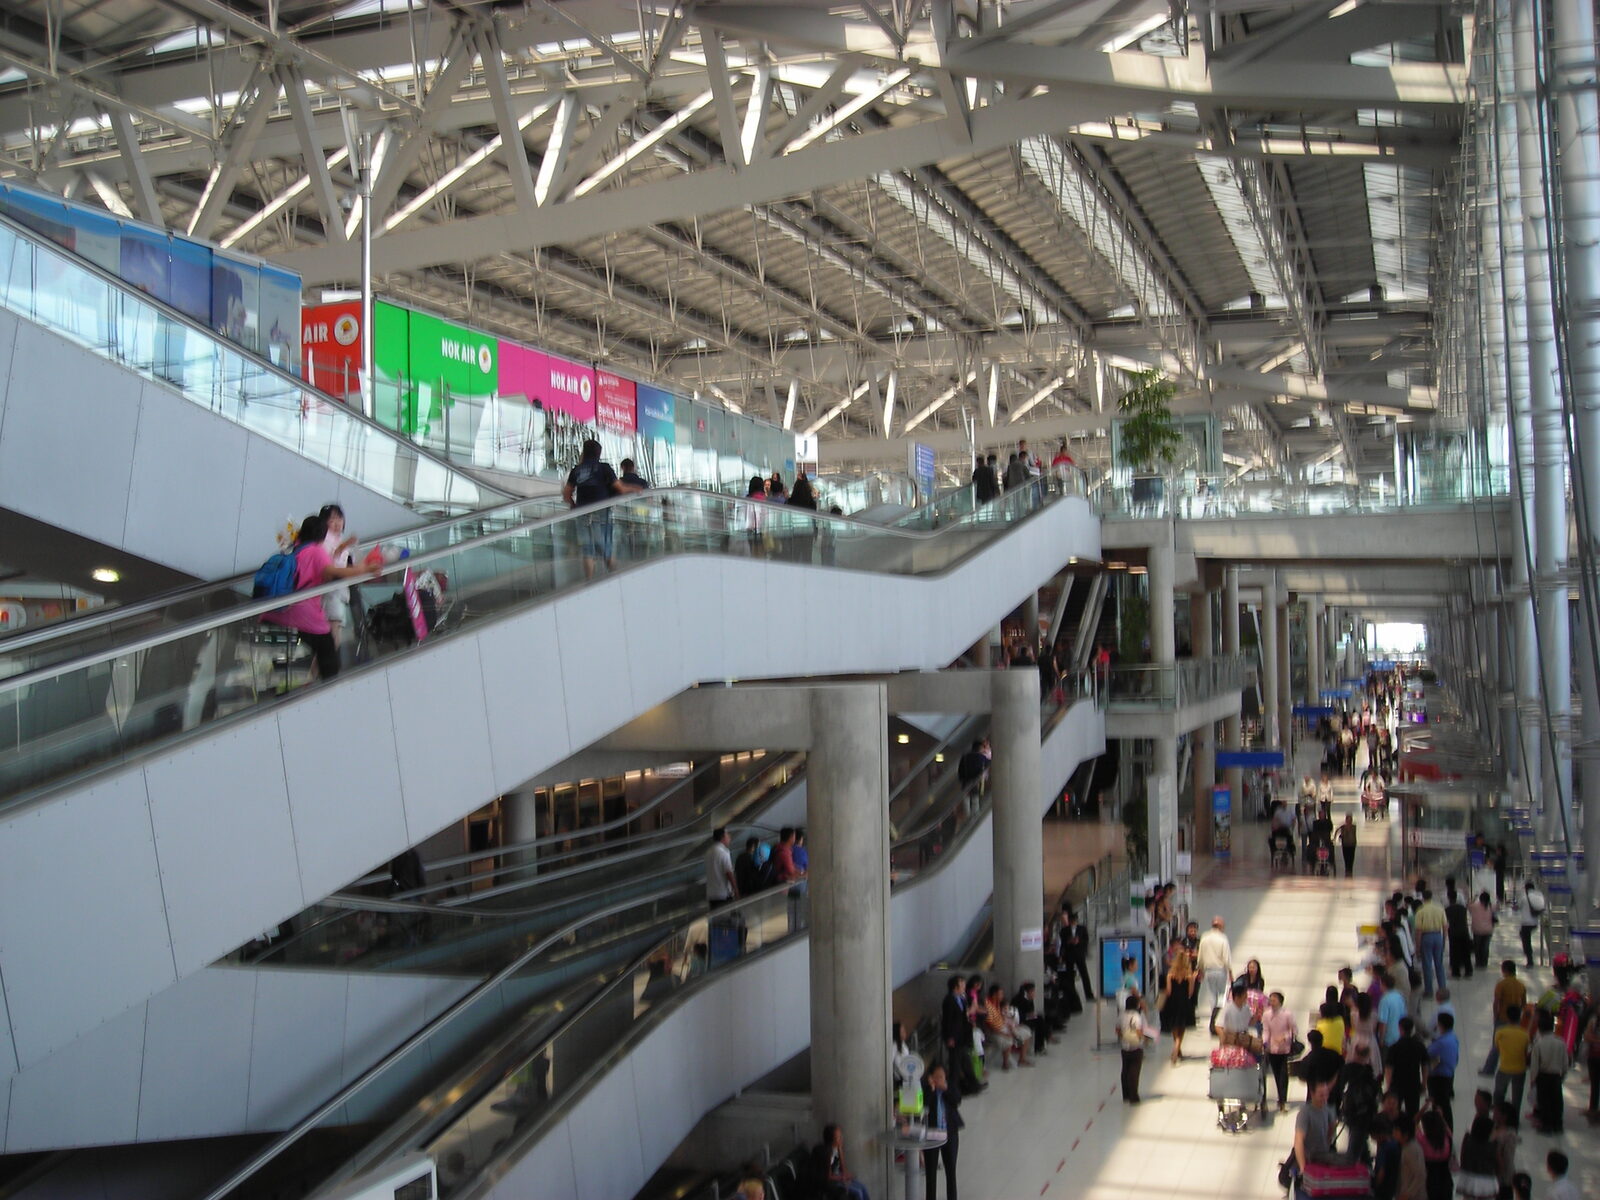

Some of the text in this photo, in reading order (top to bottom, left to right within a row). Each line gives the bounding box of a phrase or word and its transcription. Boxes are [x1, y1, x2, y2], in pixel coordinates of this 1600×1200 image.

[303, 323, 328, 344] AIR
[441, 337, 476, 365] NOK AIR
[551, 370, 566, 389] NOK
[567, 376, 578, 394] AIR
